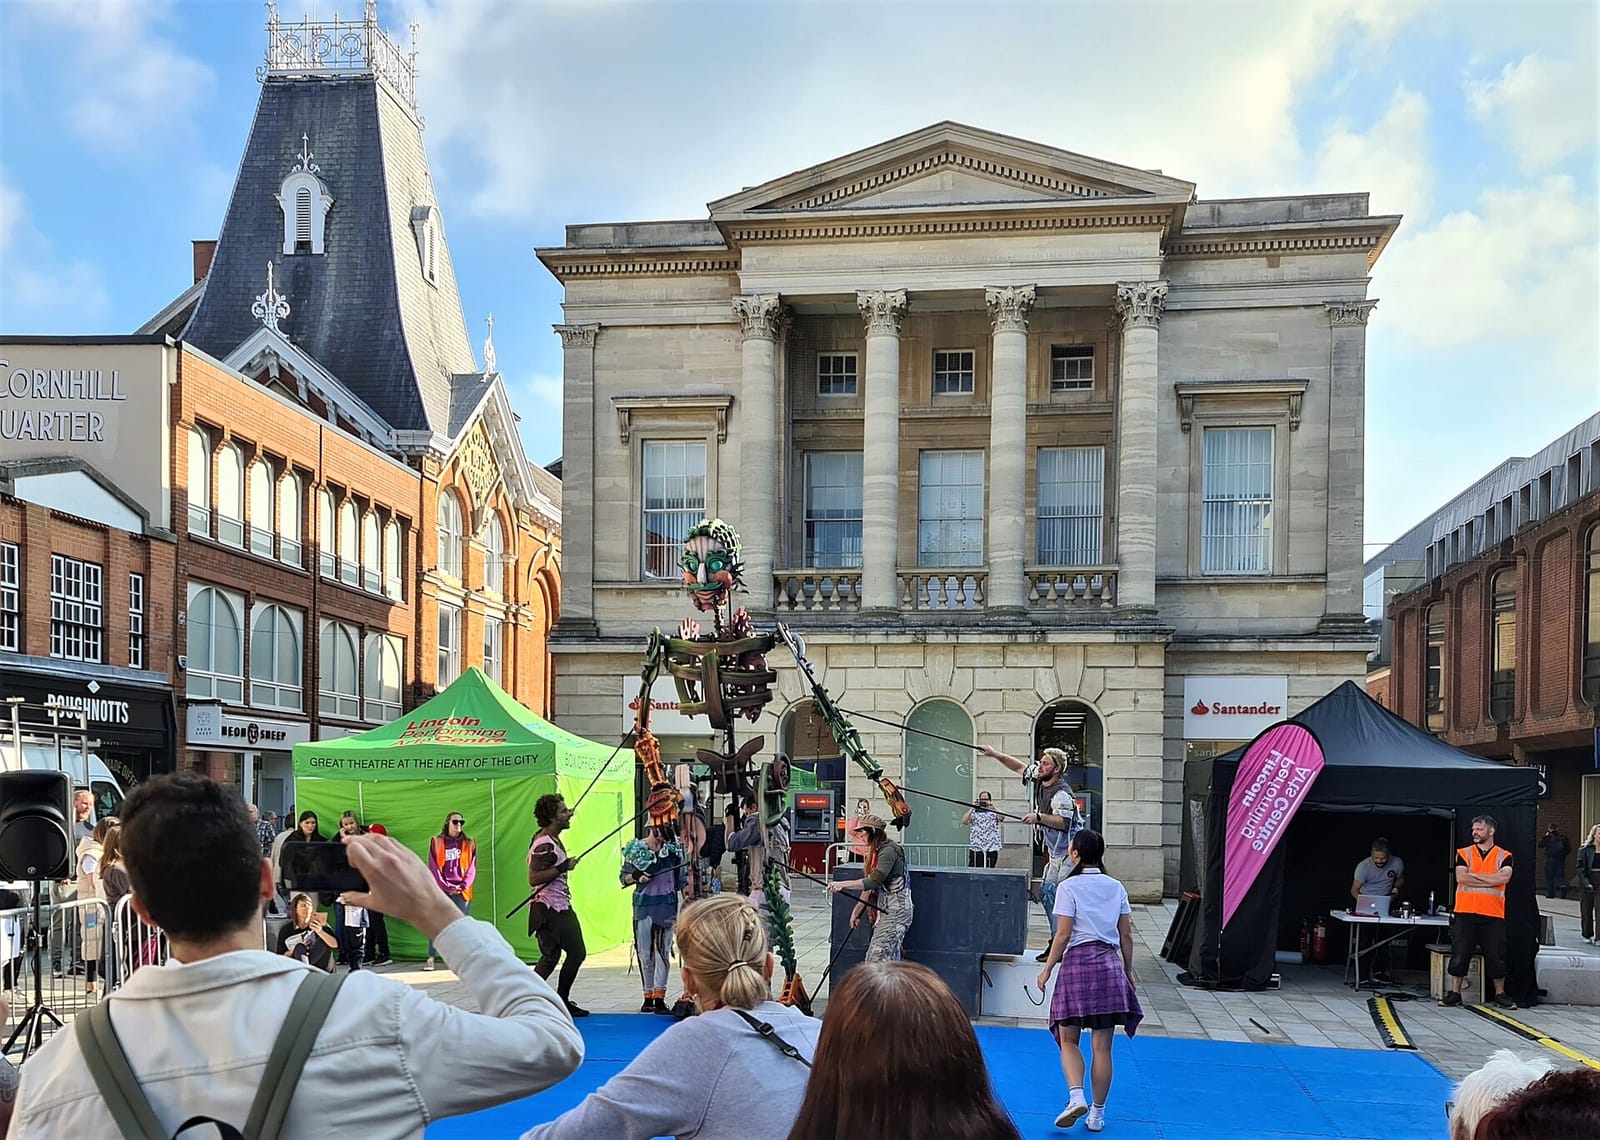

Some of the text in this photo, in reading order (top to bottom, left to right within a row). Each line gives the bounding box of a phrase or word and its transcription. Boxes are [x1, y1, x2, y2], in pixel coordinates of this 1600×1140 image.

[0, 409, 104, 442] UARTER
[47, 693, 129, 724] DOUGHNOTTS
[649, 698, 680, 710] Santa
[1212, 701, 1281, 715] Santander
[407, 716, 481, 731] Lincoln
[221, 725, 287, 741] NEON SHEEP
[399, 728, 507, 739] Performing
[435, 735, 507, 744] Centre
[309, 754, 539, 769] GREAT THEATRE AT THE HEART OF THE CITY
